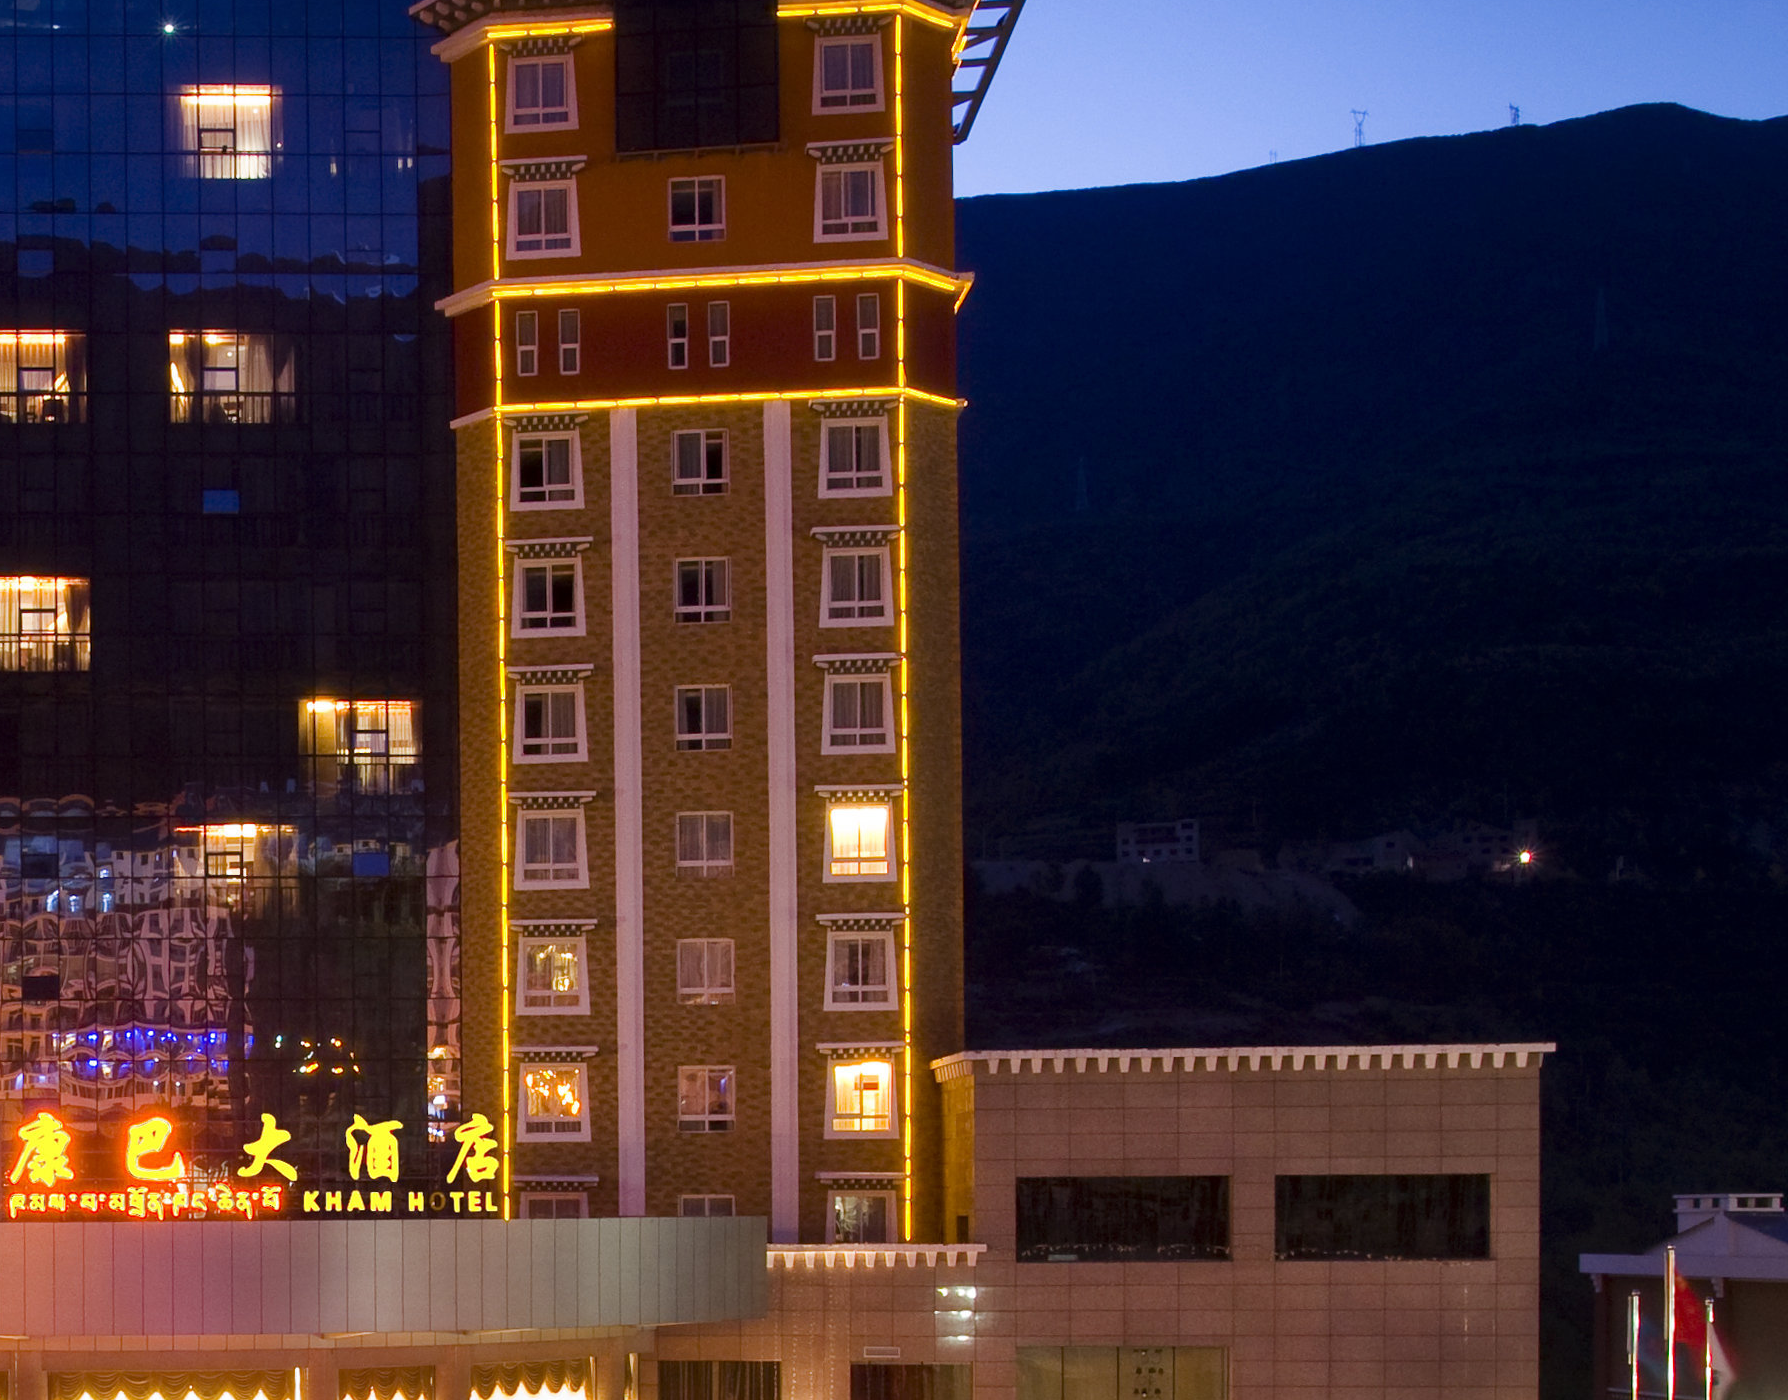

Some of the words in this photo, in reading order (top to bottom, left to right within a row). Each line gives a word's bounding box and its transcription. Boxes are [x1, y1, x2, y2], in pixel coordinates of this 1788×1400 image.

[9, 1112, 500, 1184] 康巴大酒店
[303, 1190, 392, 1212] KHAM
[408, 1191, 498, 1213] HOTEL
